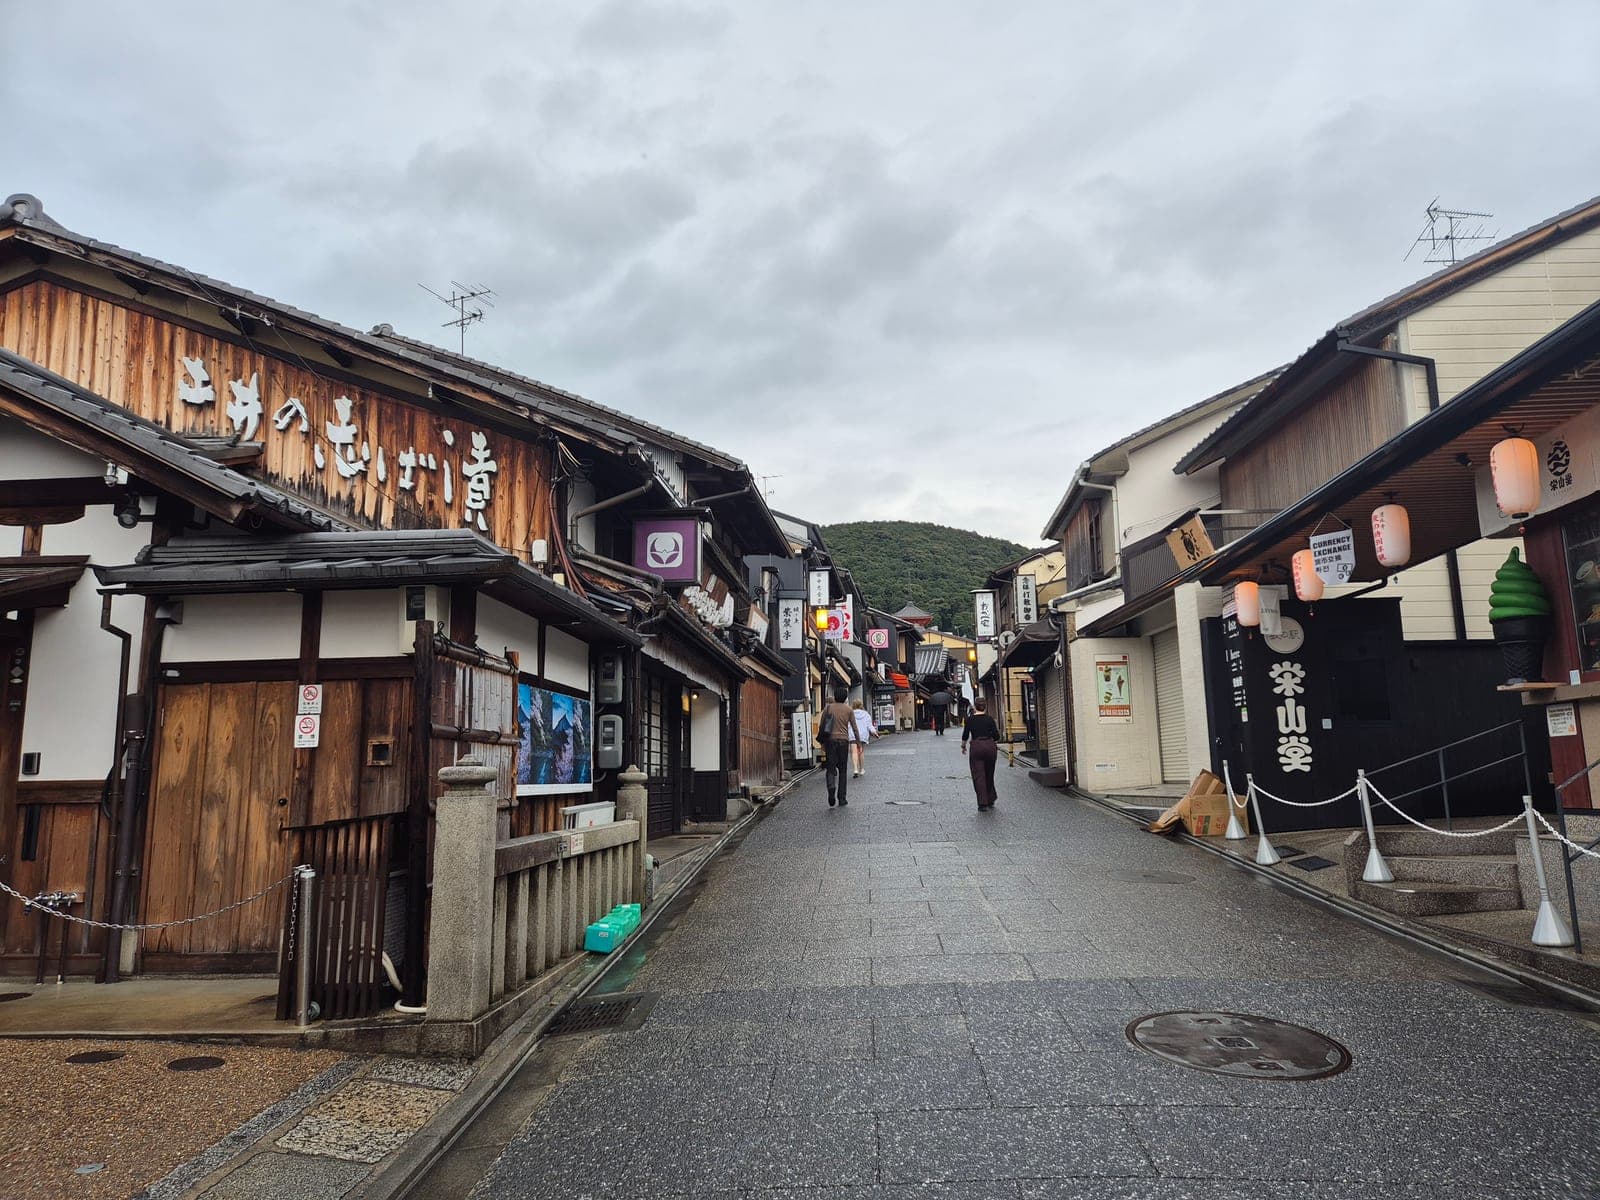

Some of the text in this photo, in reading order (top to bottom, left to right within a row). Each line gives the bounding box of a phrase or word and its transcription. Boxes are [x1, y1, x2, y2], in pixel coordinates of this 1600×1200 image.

[1313, 536, 1350, 549] CURRENCY
[1314, 544, 1351, 557] EXCHANGE
[1268, 660, 1313, 773] 栄山堂
